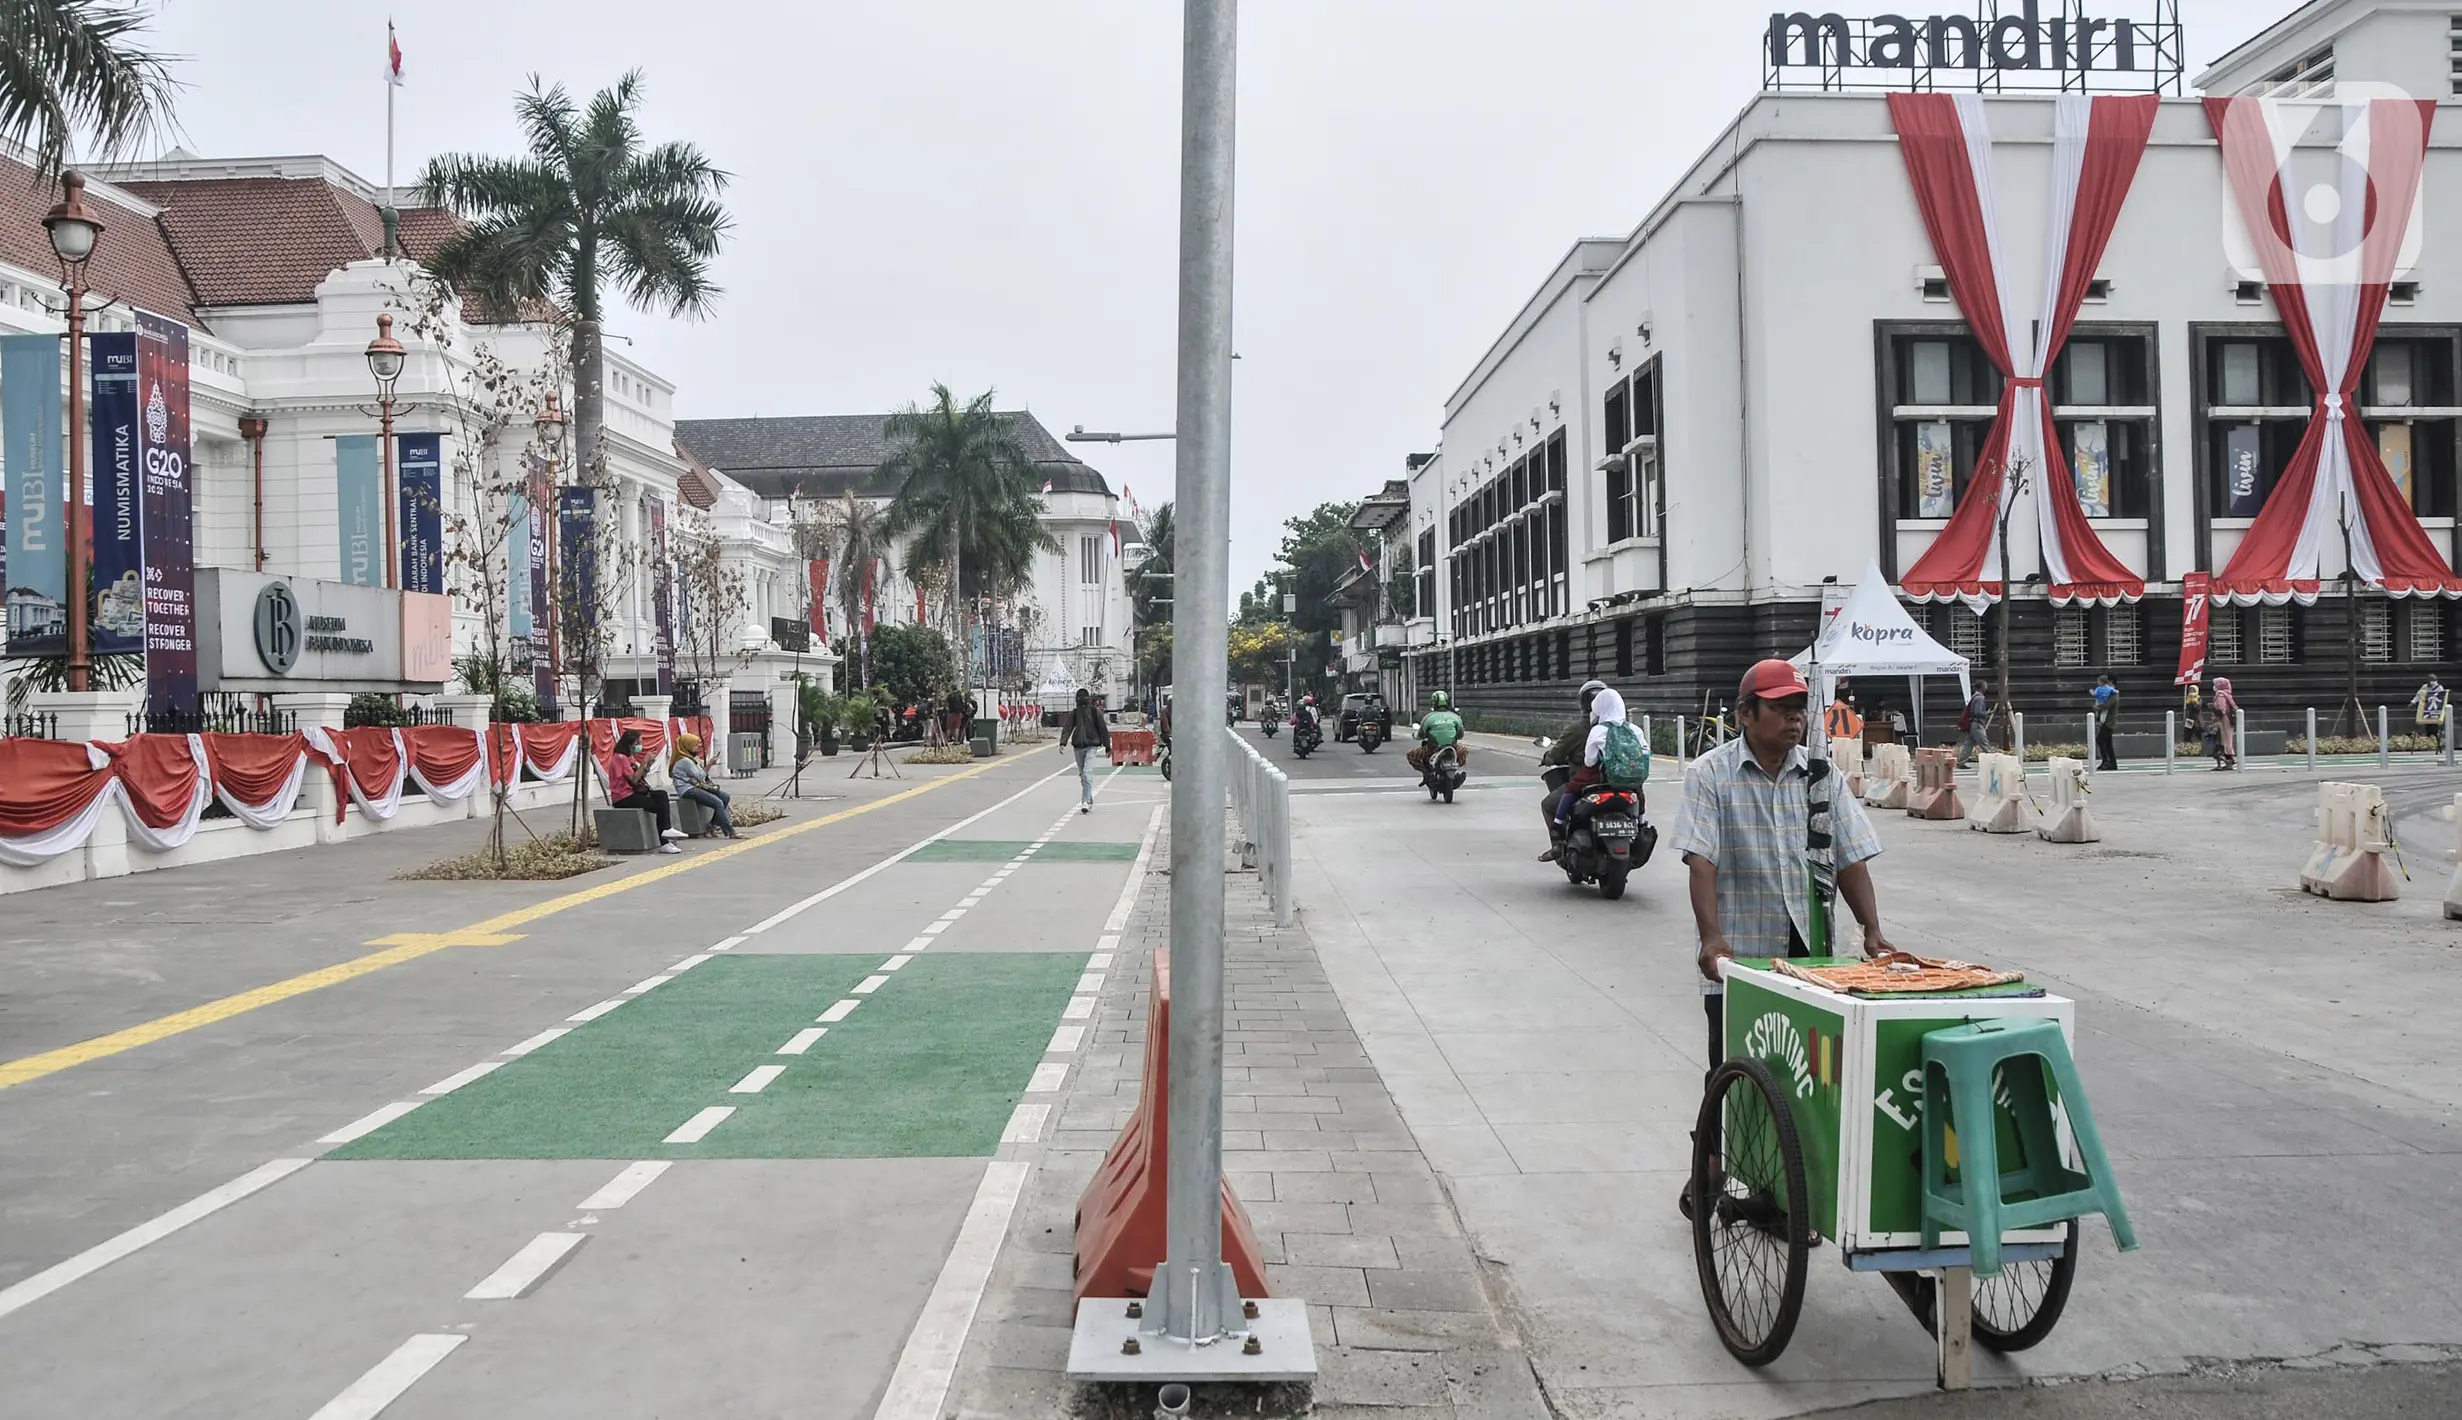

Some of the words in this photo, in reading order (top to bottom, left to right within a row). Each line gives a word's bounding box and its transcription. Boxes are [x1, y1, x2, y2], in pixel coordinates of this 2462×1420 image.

[1770, 0, 2134, 70] mandiri
[146, 447, 183, 479] G20
[115, 424, 131, 540] NUMISMATIKA
[147, 587, 185, 602] RECOVER
[147, 601, 190, 616] TOGETHER
[2185, 594, 2206, 625] 77
[148, 623, 186, 636] RECOVER
[1851, 621, 1914, 646] kopra
[148, 638, 192, 651] STRONGER
